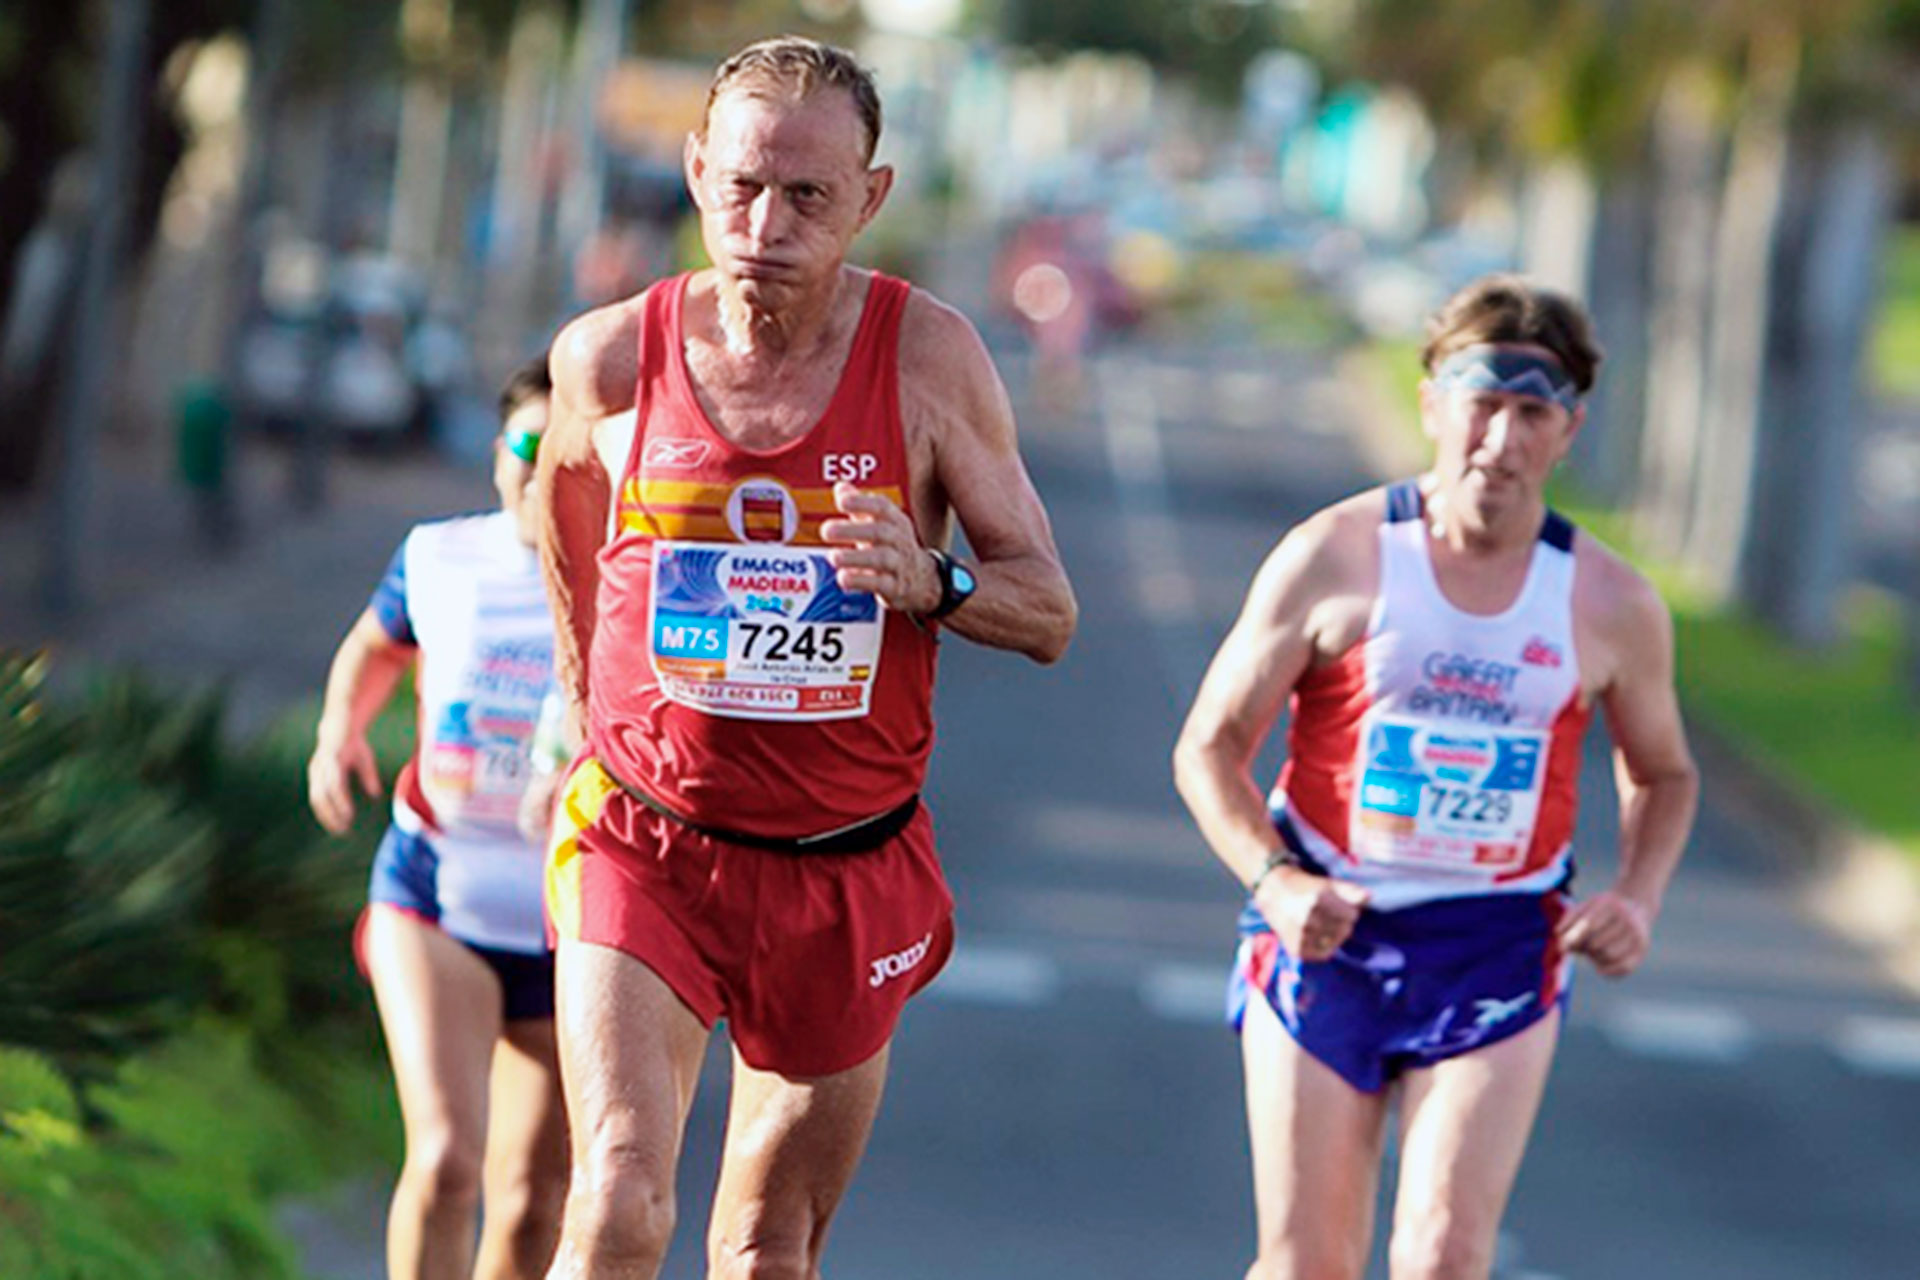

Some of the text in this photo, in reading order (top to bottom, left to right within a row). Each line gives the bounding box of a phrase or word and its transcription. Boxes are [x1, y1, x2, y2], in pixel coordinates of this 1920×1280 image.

[822, 454, 877, 481] ESP
[732, 557, 808, 575] EMACNS
[728, 575, 810, 593] MADEIRA
[660, 625, 720, 651] M75
[738, 623, 844, 662] 7245
[1427, 785, 1513, 824] 7229
